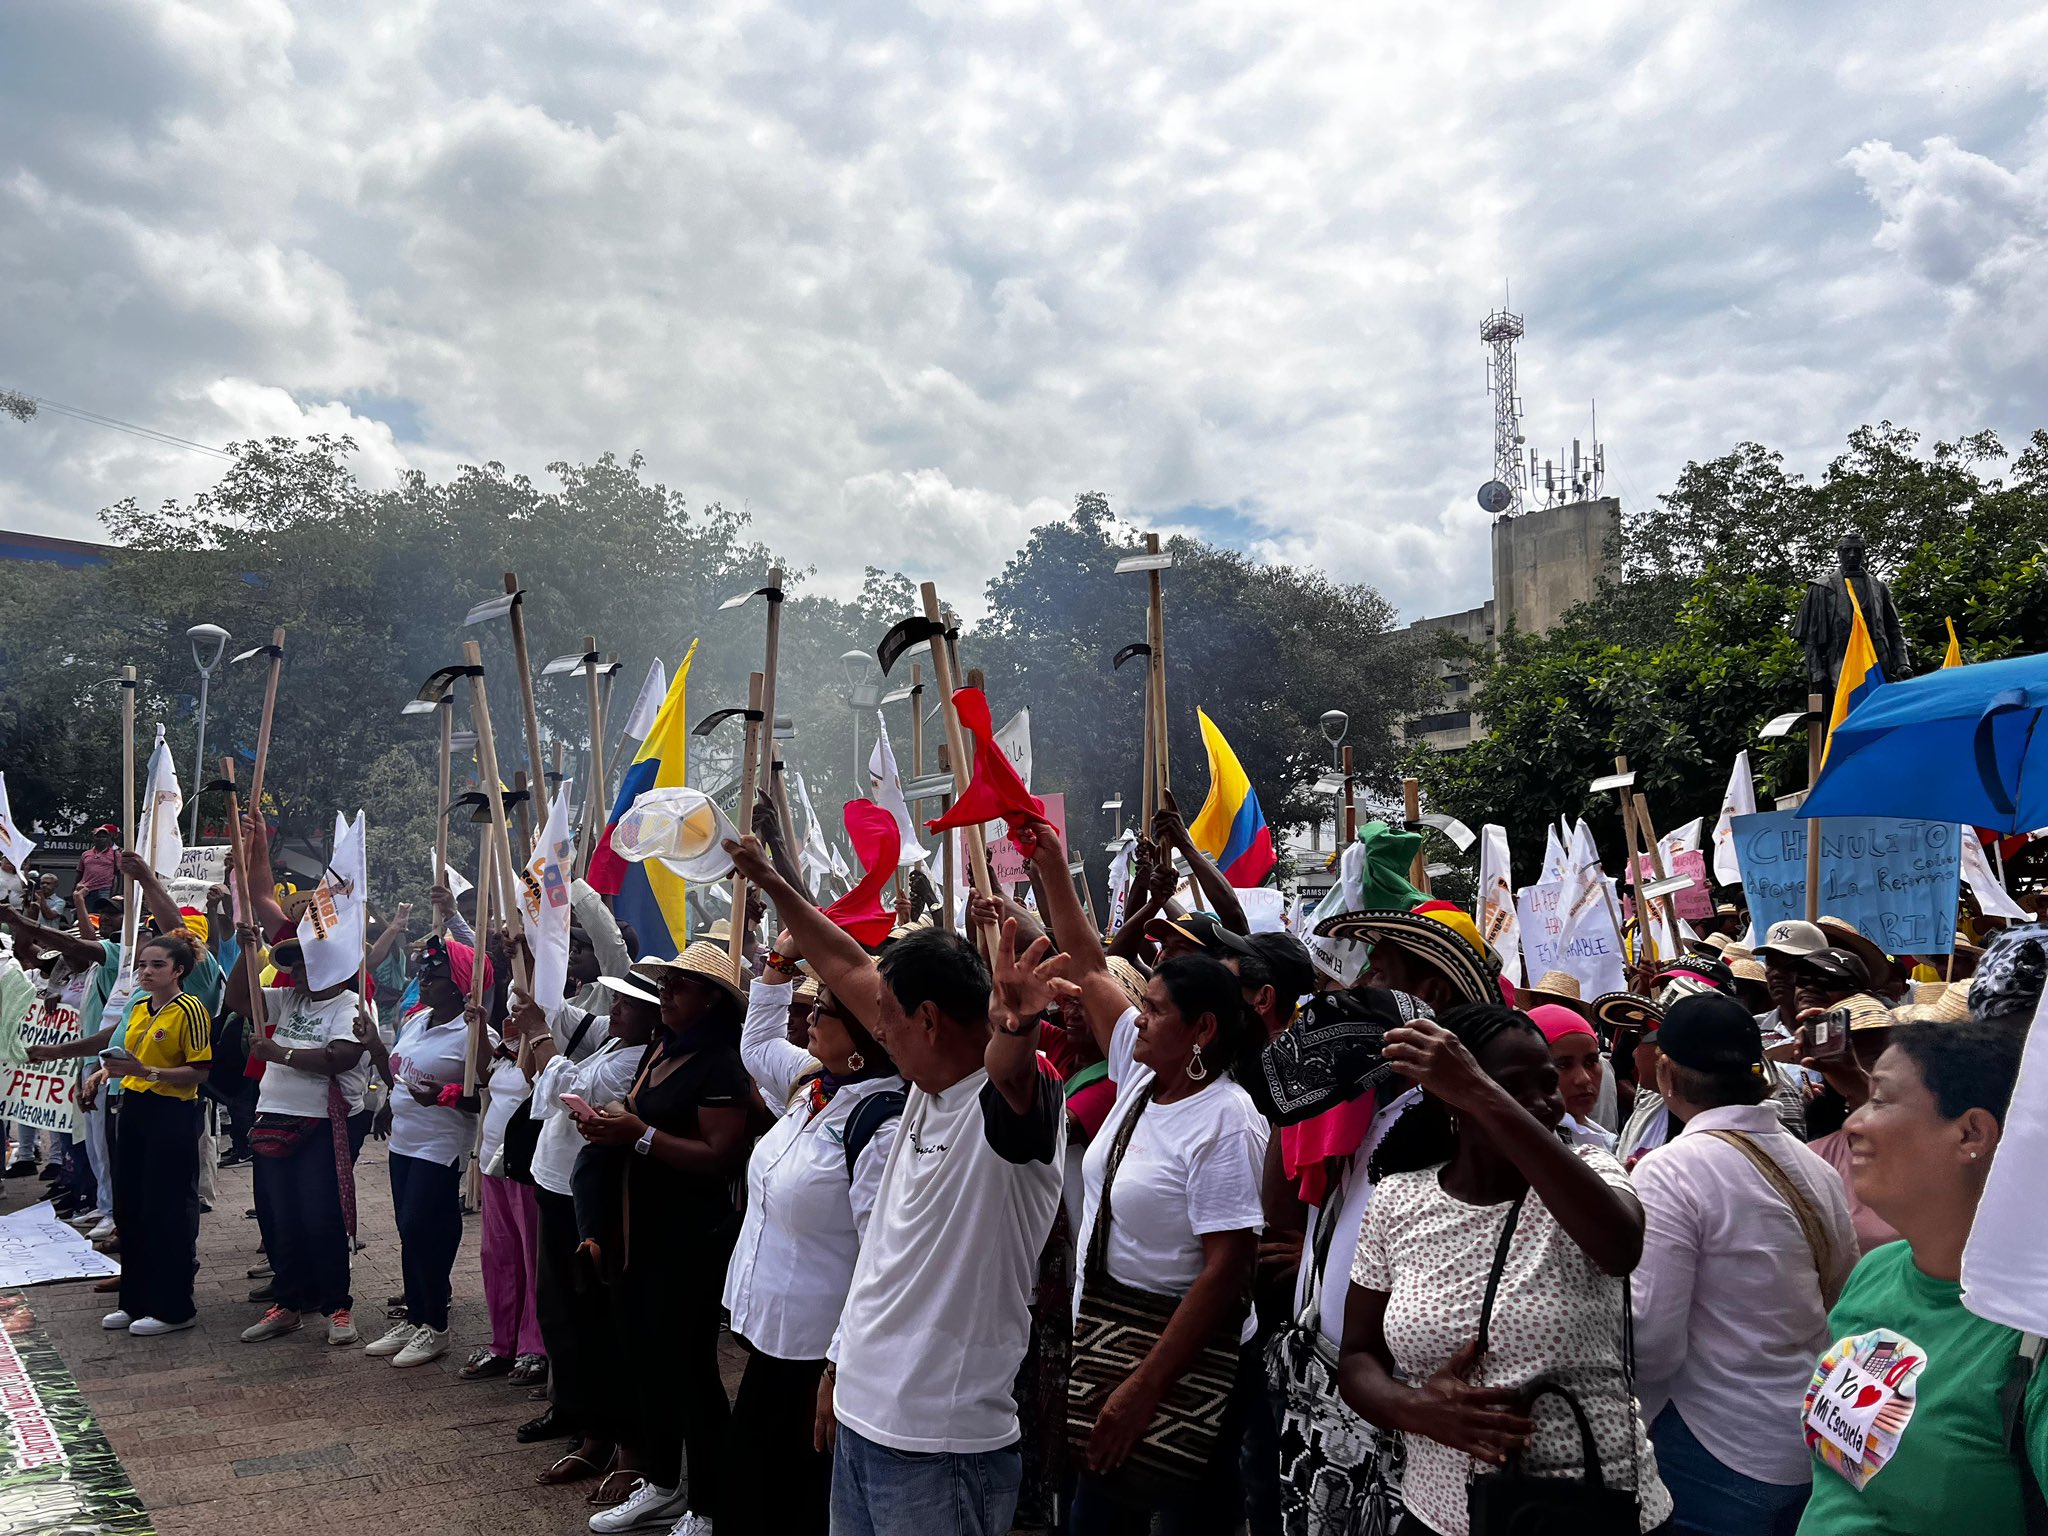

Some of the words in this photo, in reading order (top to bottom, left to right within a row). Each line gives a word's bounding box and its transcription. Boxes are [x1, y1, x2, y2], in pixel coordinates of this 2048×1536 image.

[1827, 869, 1862, 900] La
[1834, 1368, 1858, 1400] Yo
[1813, 1395, 1830, 1421] Mi
[1826, 1406, 1864, 1453] Escuela
